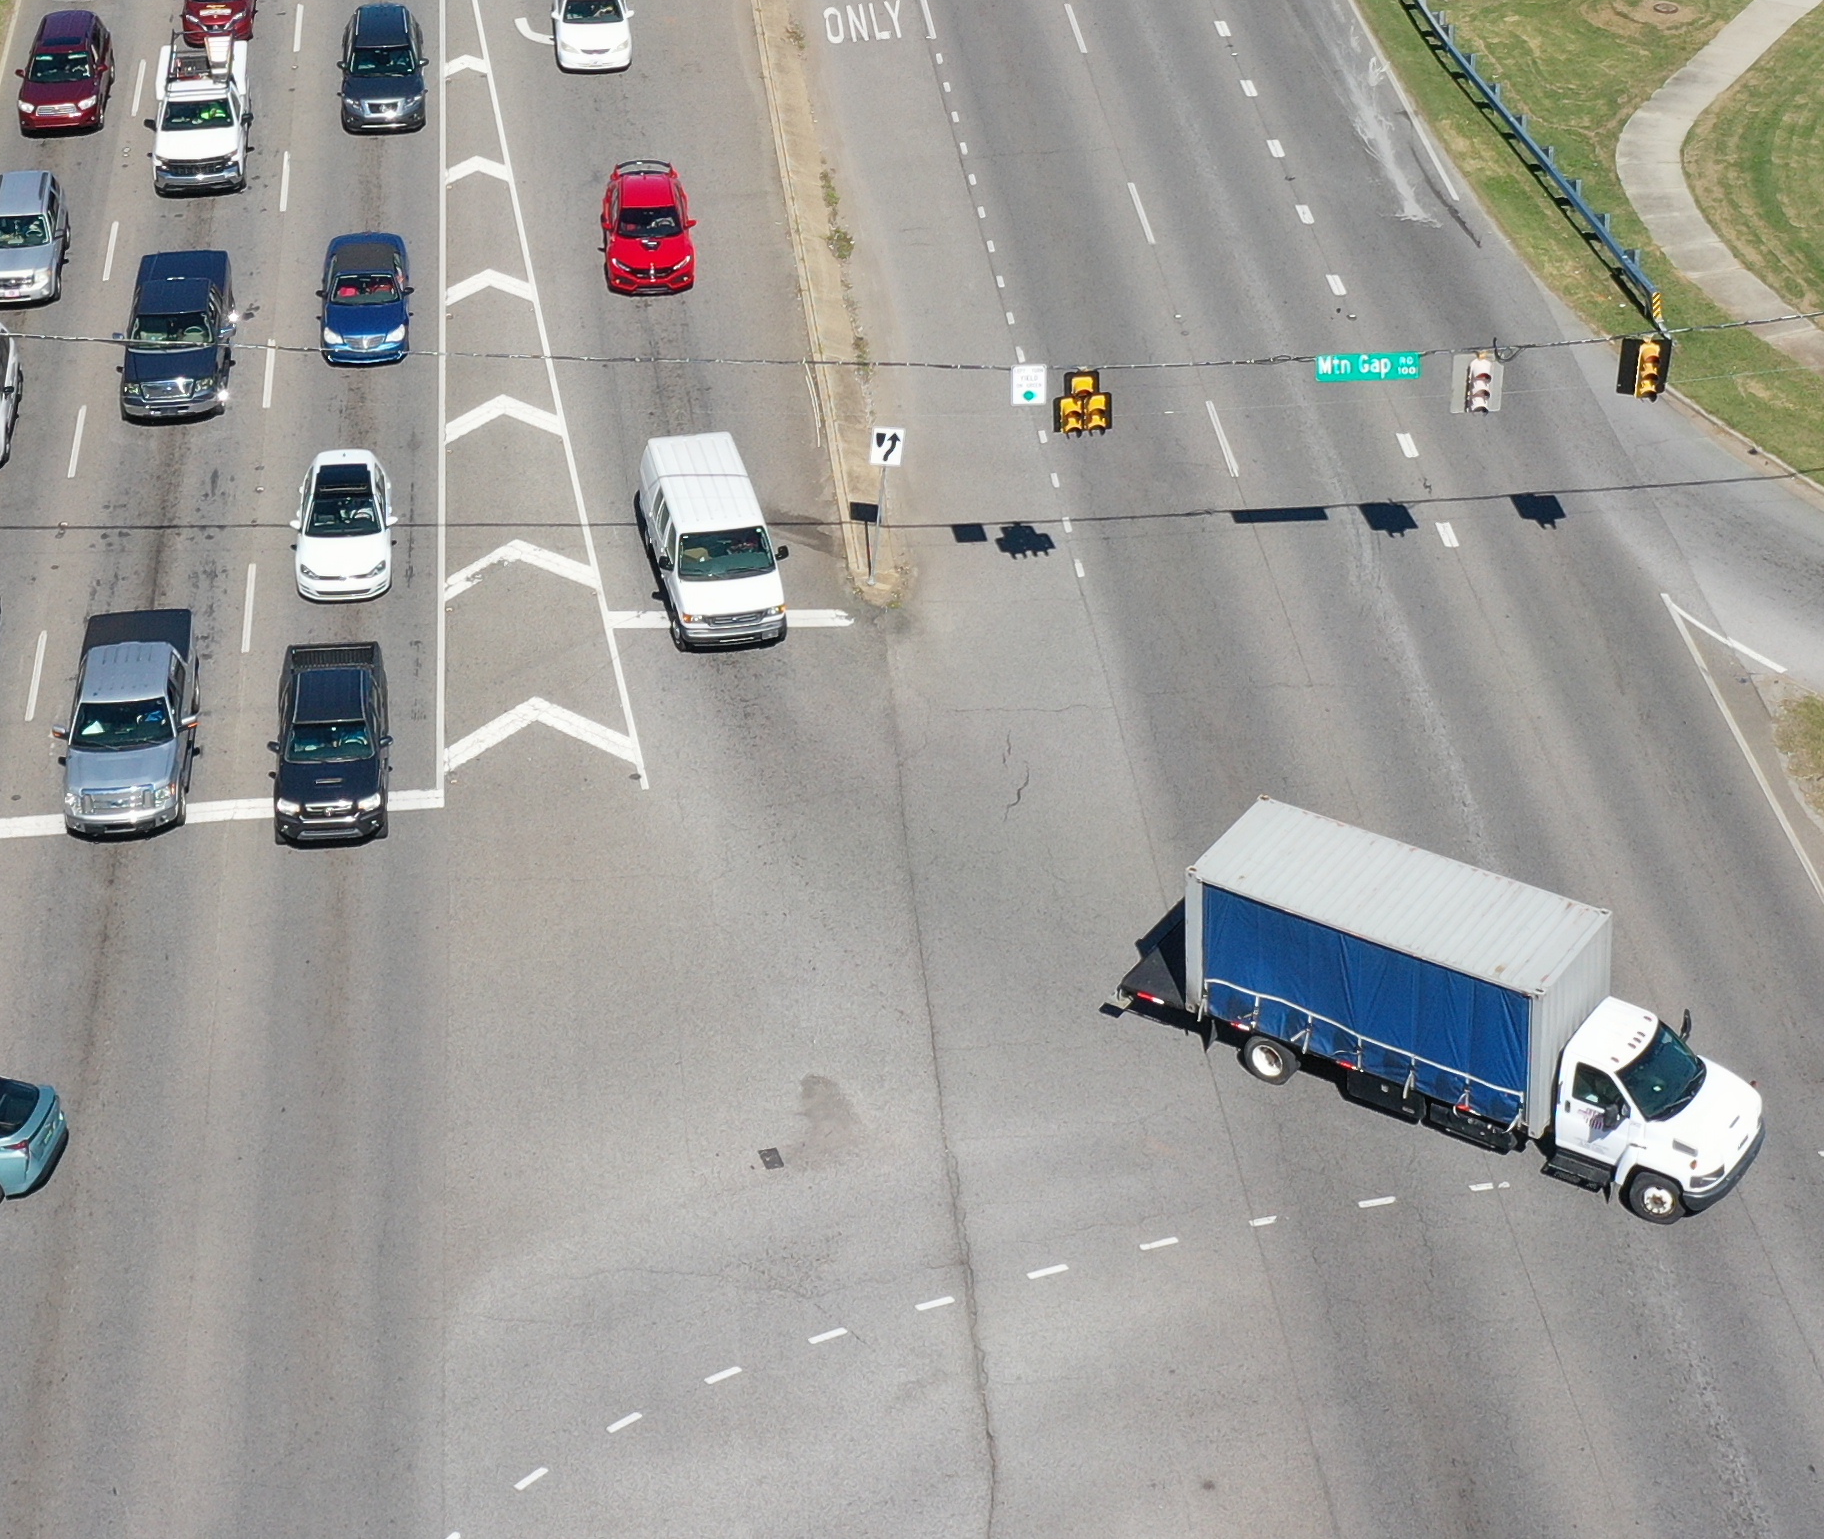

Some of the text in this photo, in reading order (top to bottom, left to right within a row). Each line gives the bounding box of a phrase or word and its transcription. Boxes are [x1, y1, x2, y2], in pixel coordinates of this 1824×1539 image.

[823, 0, 902, 44] ONLY
[1318, 355, 1351, 375] Mtn
[1358, 354, 1392, 379] Gap
[1397, 366, 1416, 375] 100
